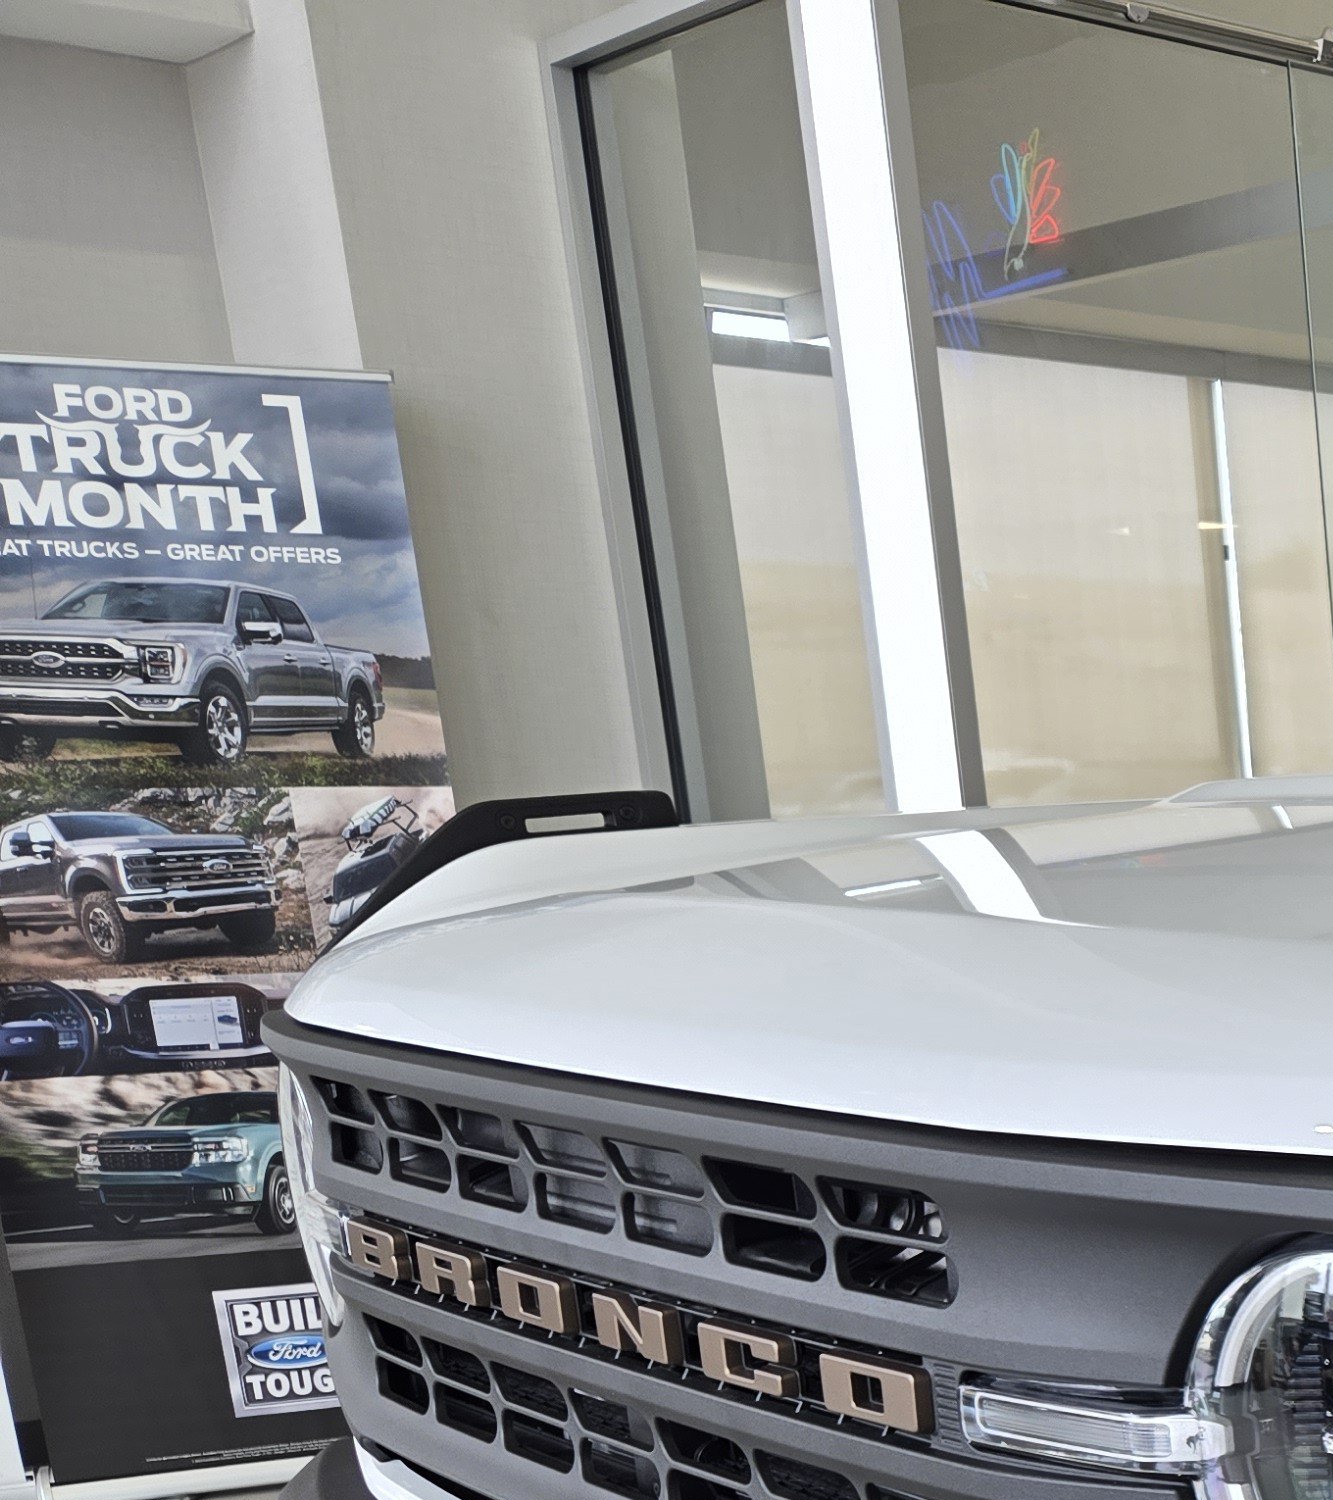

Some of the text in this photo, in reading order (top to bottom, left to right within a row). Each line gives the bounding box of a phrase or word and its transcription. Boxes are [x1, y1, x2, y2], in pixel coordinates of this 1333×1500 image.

[53, 383, 193, 422] FORD
[0, 422, 264, 482] TRUCK
[2, 479, 278, 534] MONTH
[36, 540, 140, 560] TRUCKS
[167, 543, 246, 563] GREAT
[250, 545, 342, 565] OFFERS
[233, 1298, 322, 1337] BUIL
[348, 1219, 934, 1435] BRONCO
[269, 1336, 322, 1361] Ford
[245, 1369, 335, 1400] TOUG
